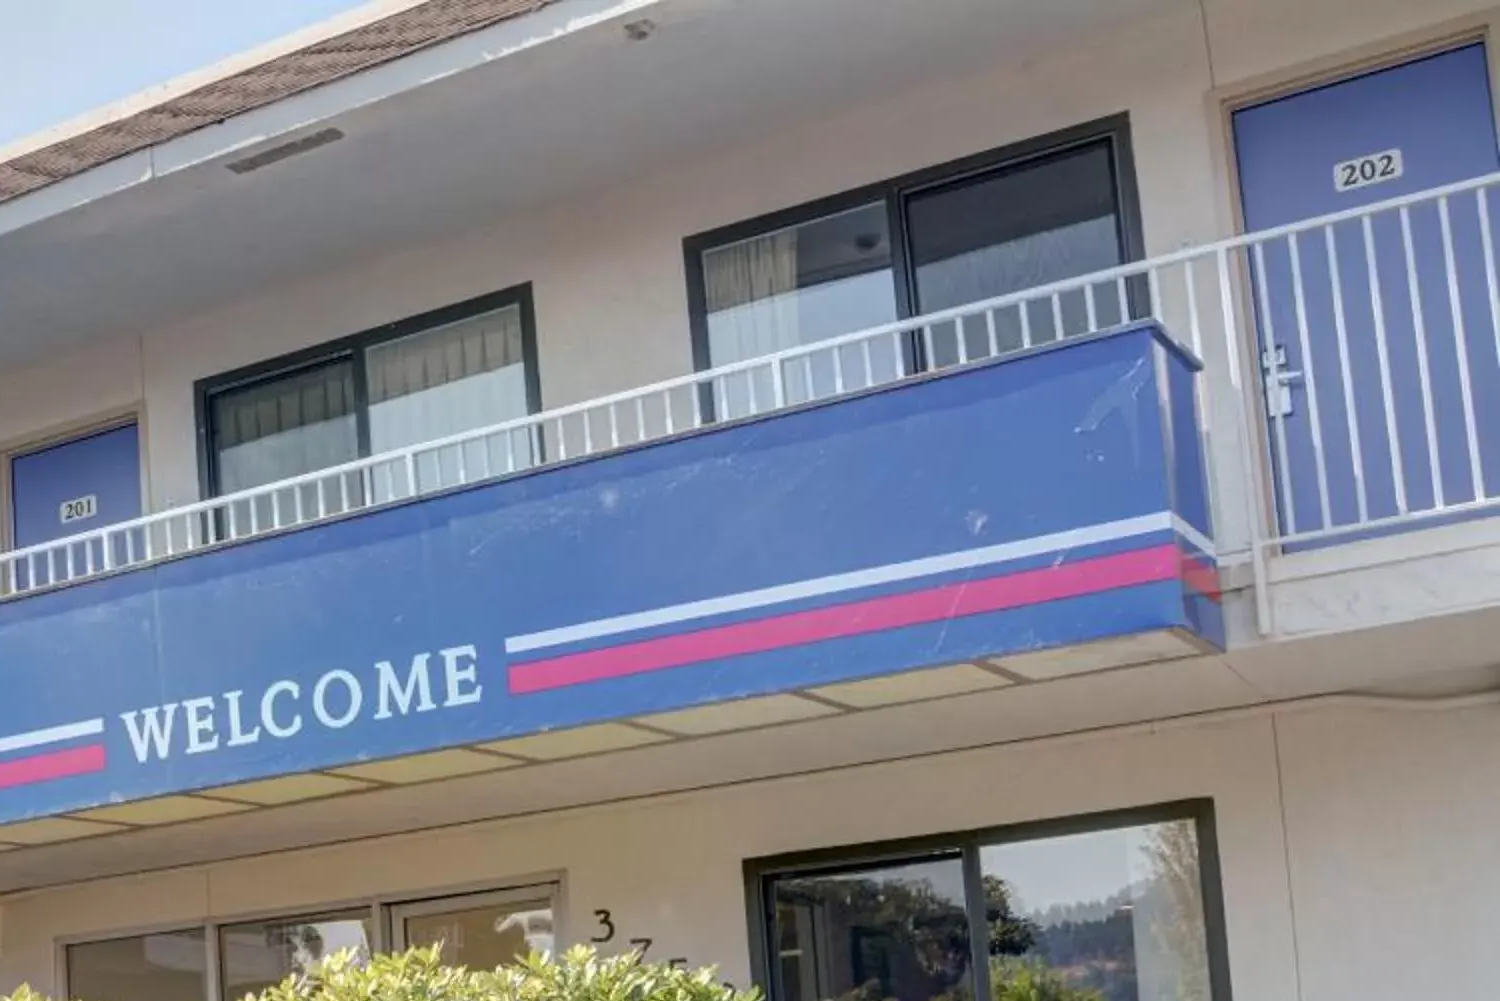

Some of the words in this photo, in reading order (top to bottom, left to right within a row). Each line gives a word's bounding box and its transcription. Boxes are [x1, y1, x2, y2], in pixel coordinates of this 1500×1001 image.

[1341, 153, 1396, 187] 202
[64, 499, 91, 520] 201
[118, 643, 484, 765] WELCOME
